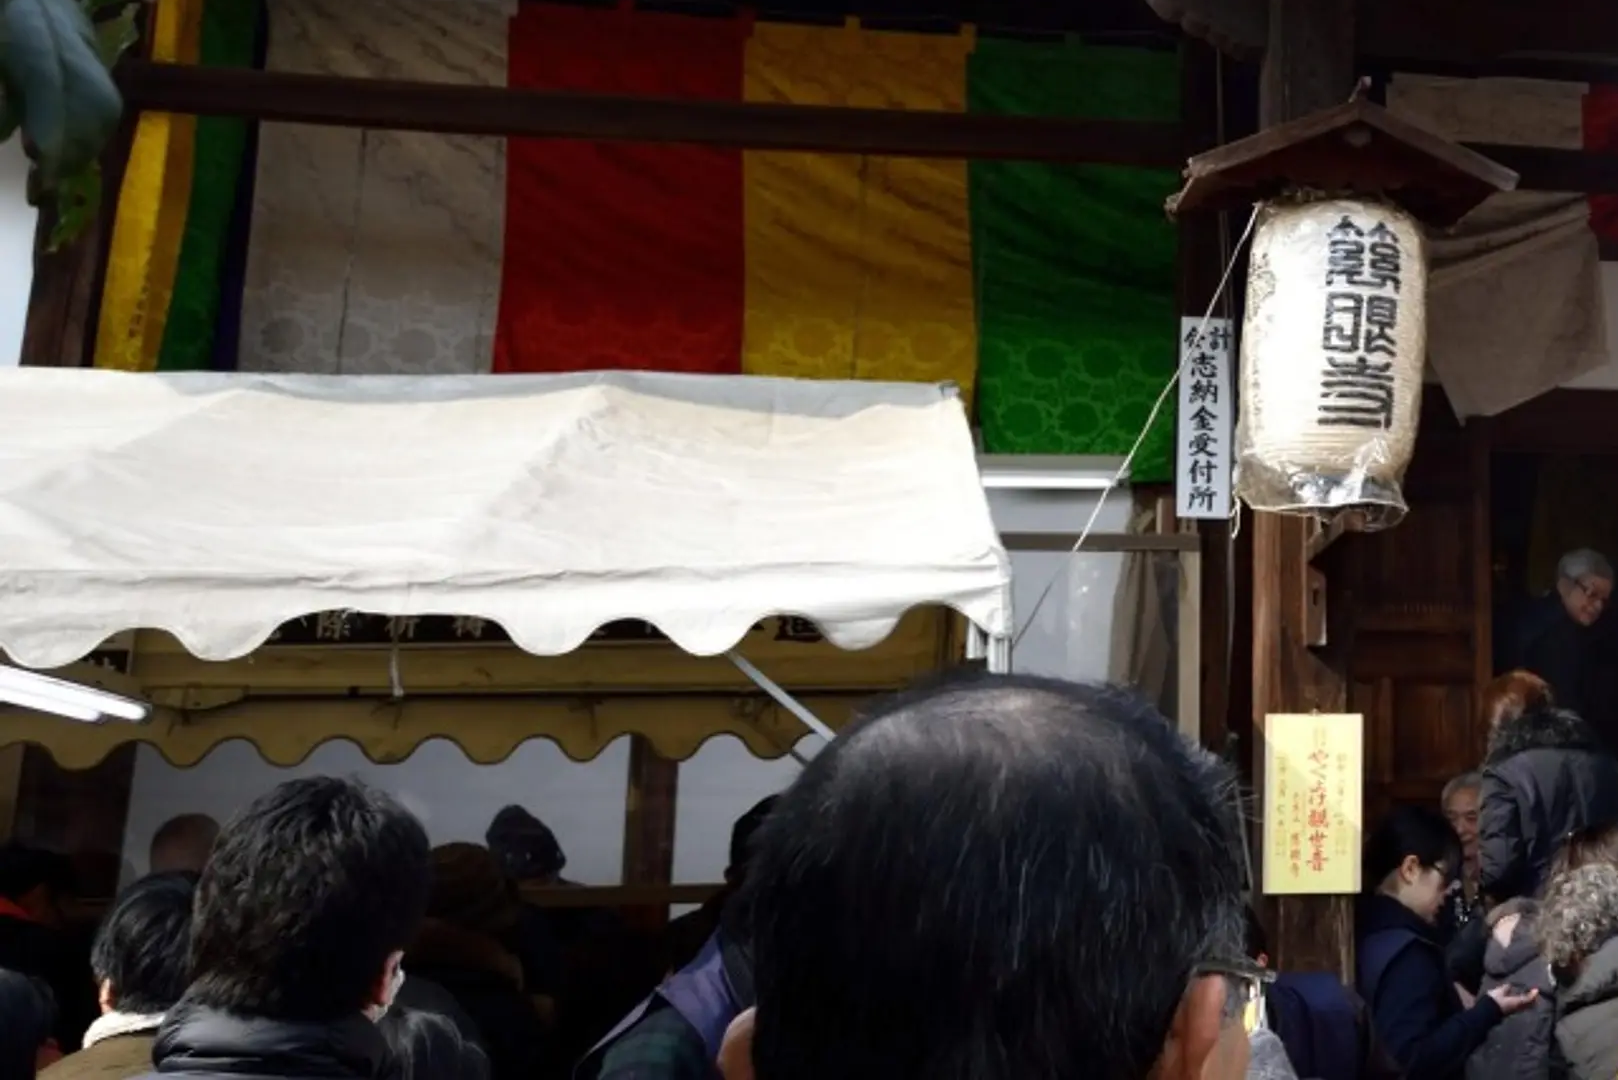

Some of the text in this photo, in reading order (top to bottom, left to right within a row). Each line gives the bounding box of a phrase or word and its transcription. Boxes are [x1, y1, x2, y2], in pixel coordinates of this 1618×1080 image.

[1187, 352, 1218, 512] 志納金受付所
